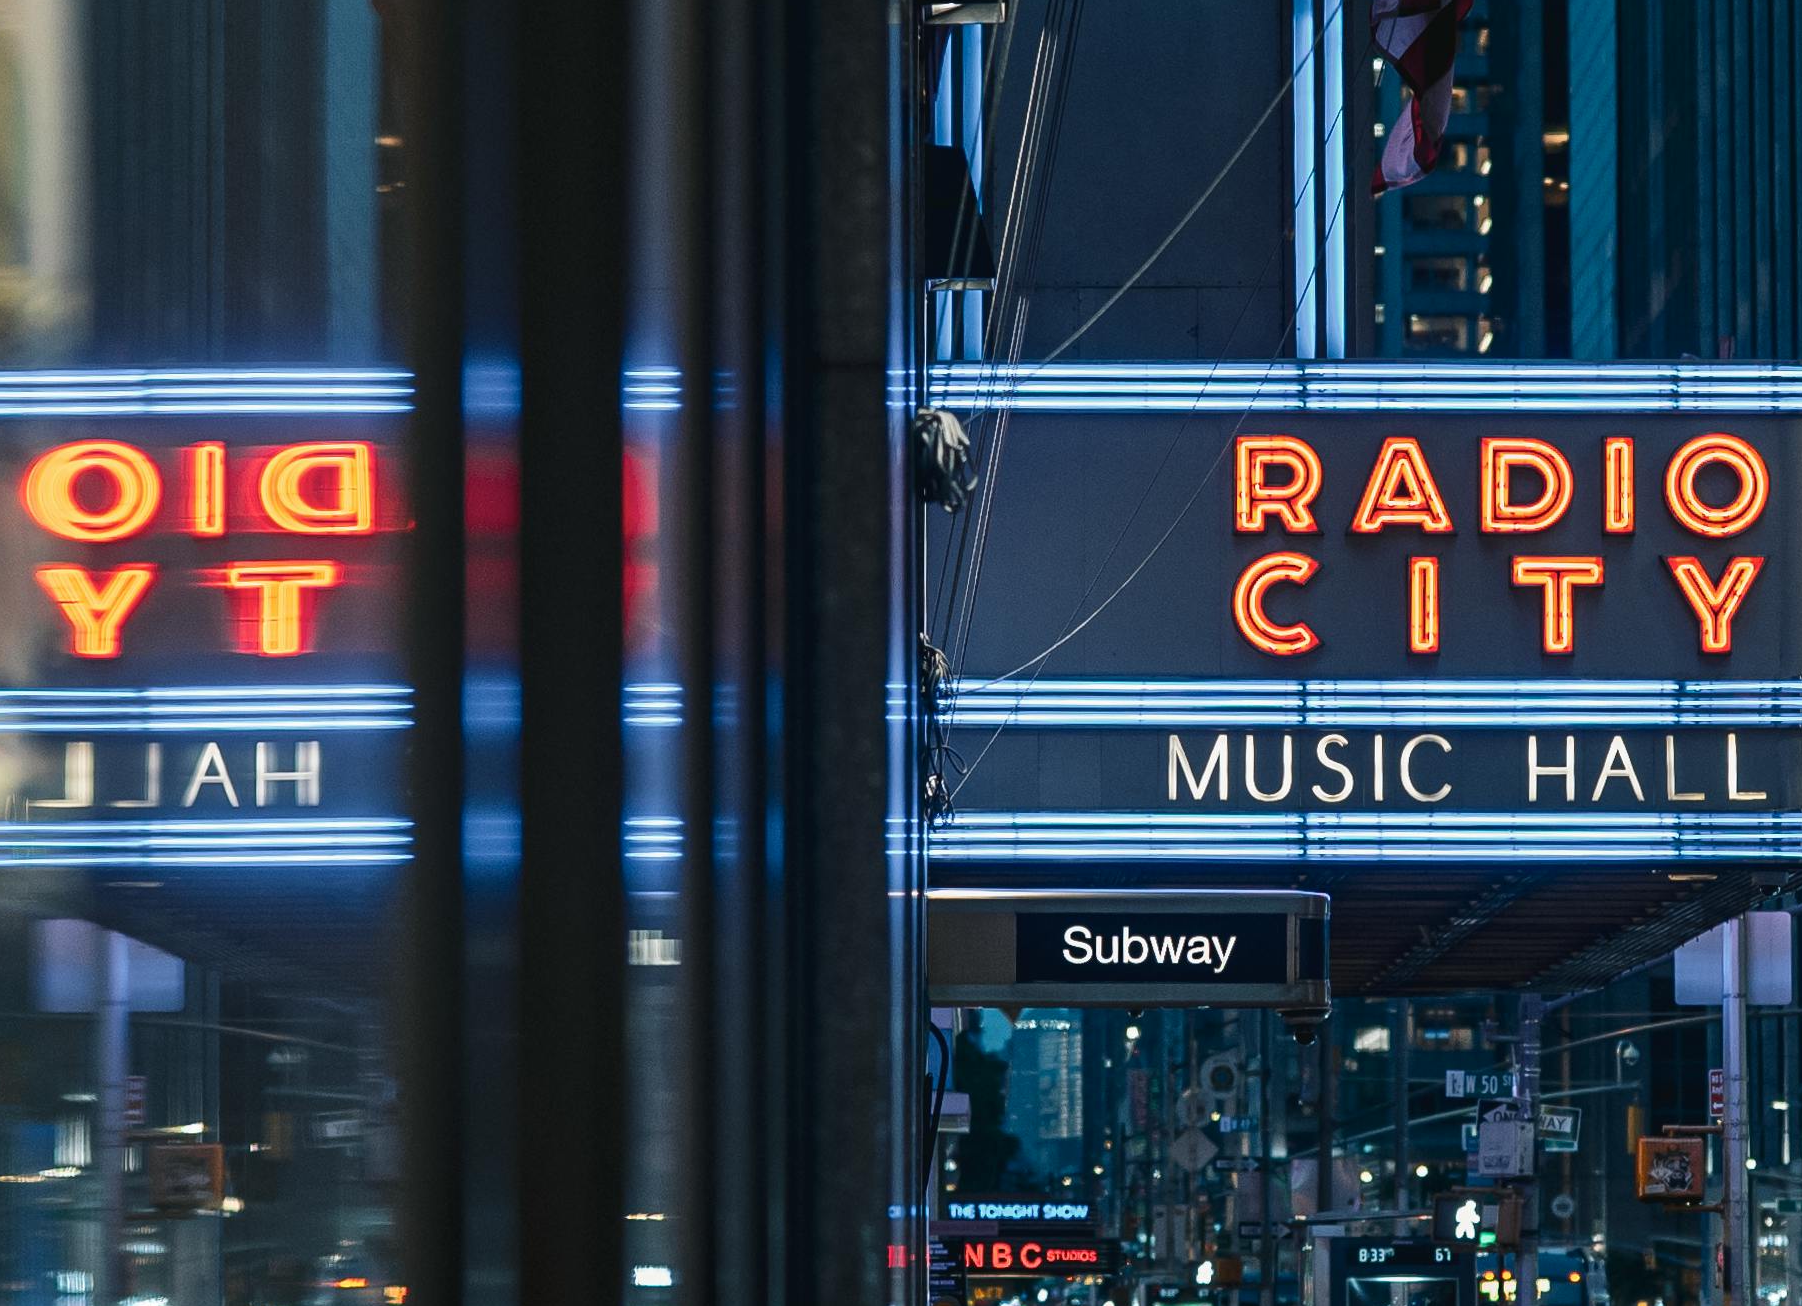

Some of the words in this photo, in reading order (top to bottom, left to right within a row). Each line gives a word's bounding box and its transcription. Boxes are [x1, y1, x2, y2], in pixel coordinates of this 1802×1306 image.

[1232, 432, 1772, 540] RADIO
[1231, 550, 1765, 657] CITY
[1167, 732, 1455, 803] MUSIC
[1527, 733, 1768, 802] HALL
[1062, 925, 1238, 974] Subway
[1466, 1075, 1476, 1094] W
[1481, 1075, 1498, 1095] 50
[949, 1203, 976, 1220] THE
[978, 1203, 1040, 1220] TONIGHT
[1043, 1203, 1089, 1220] SHOW
[1046, 1249, 1098, 1263] STUDIOS
